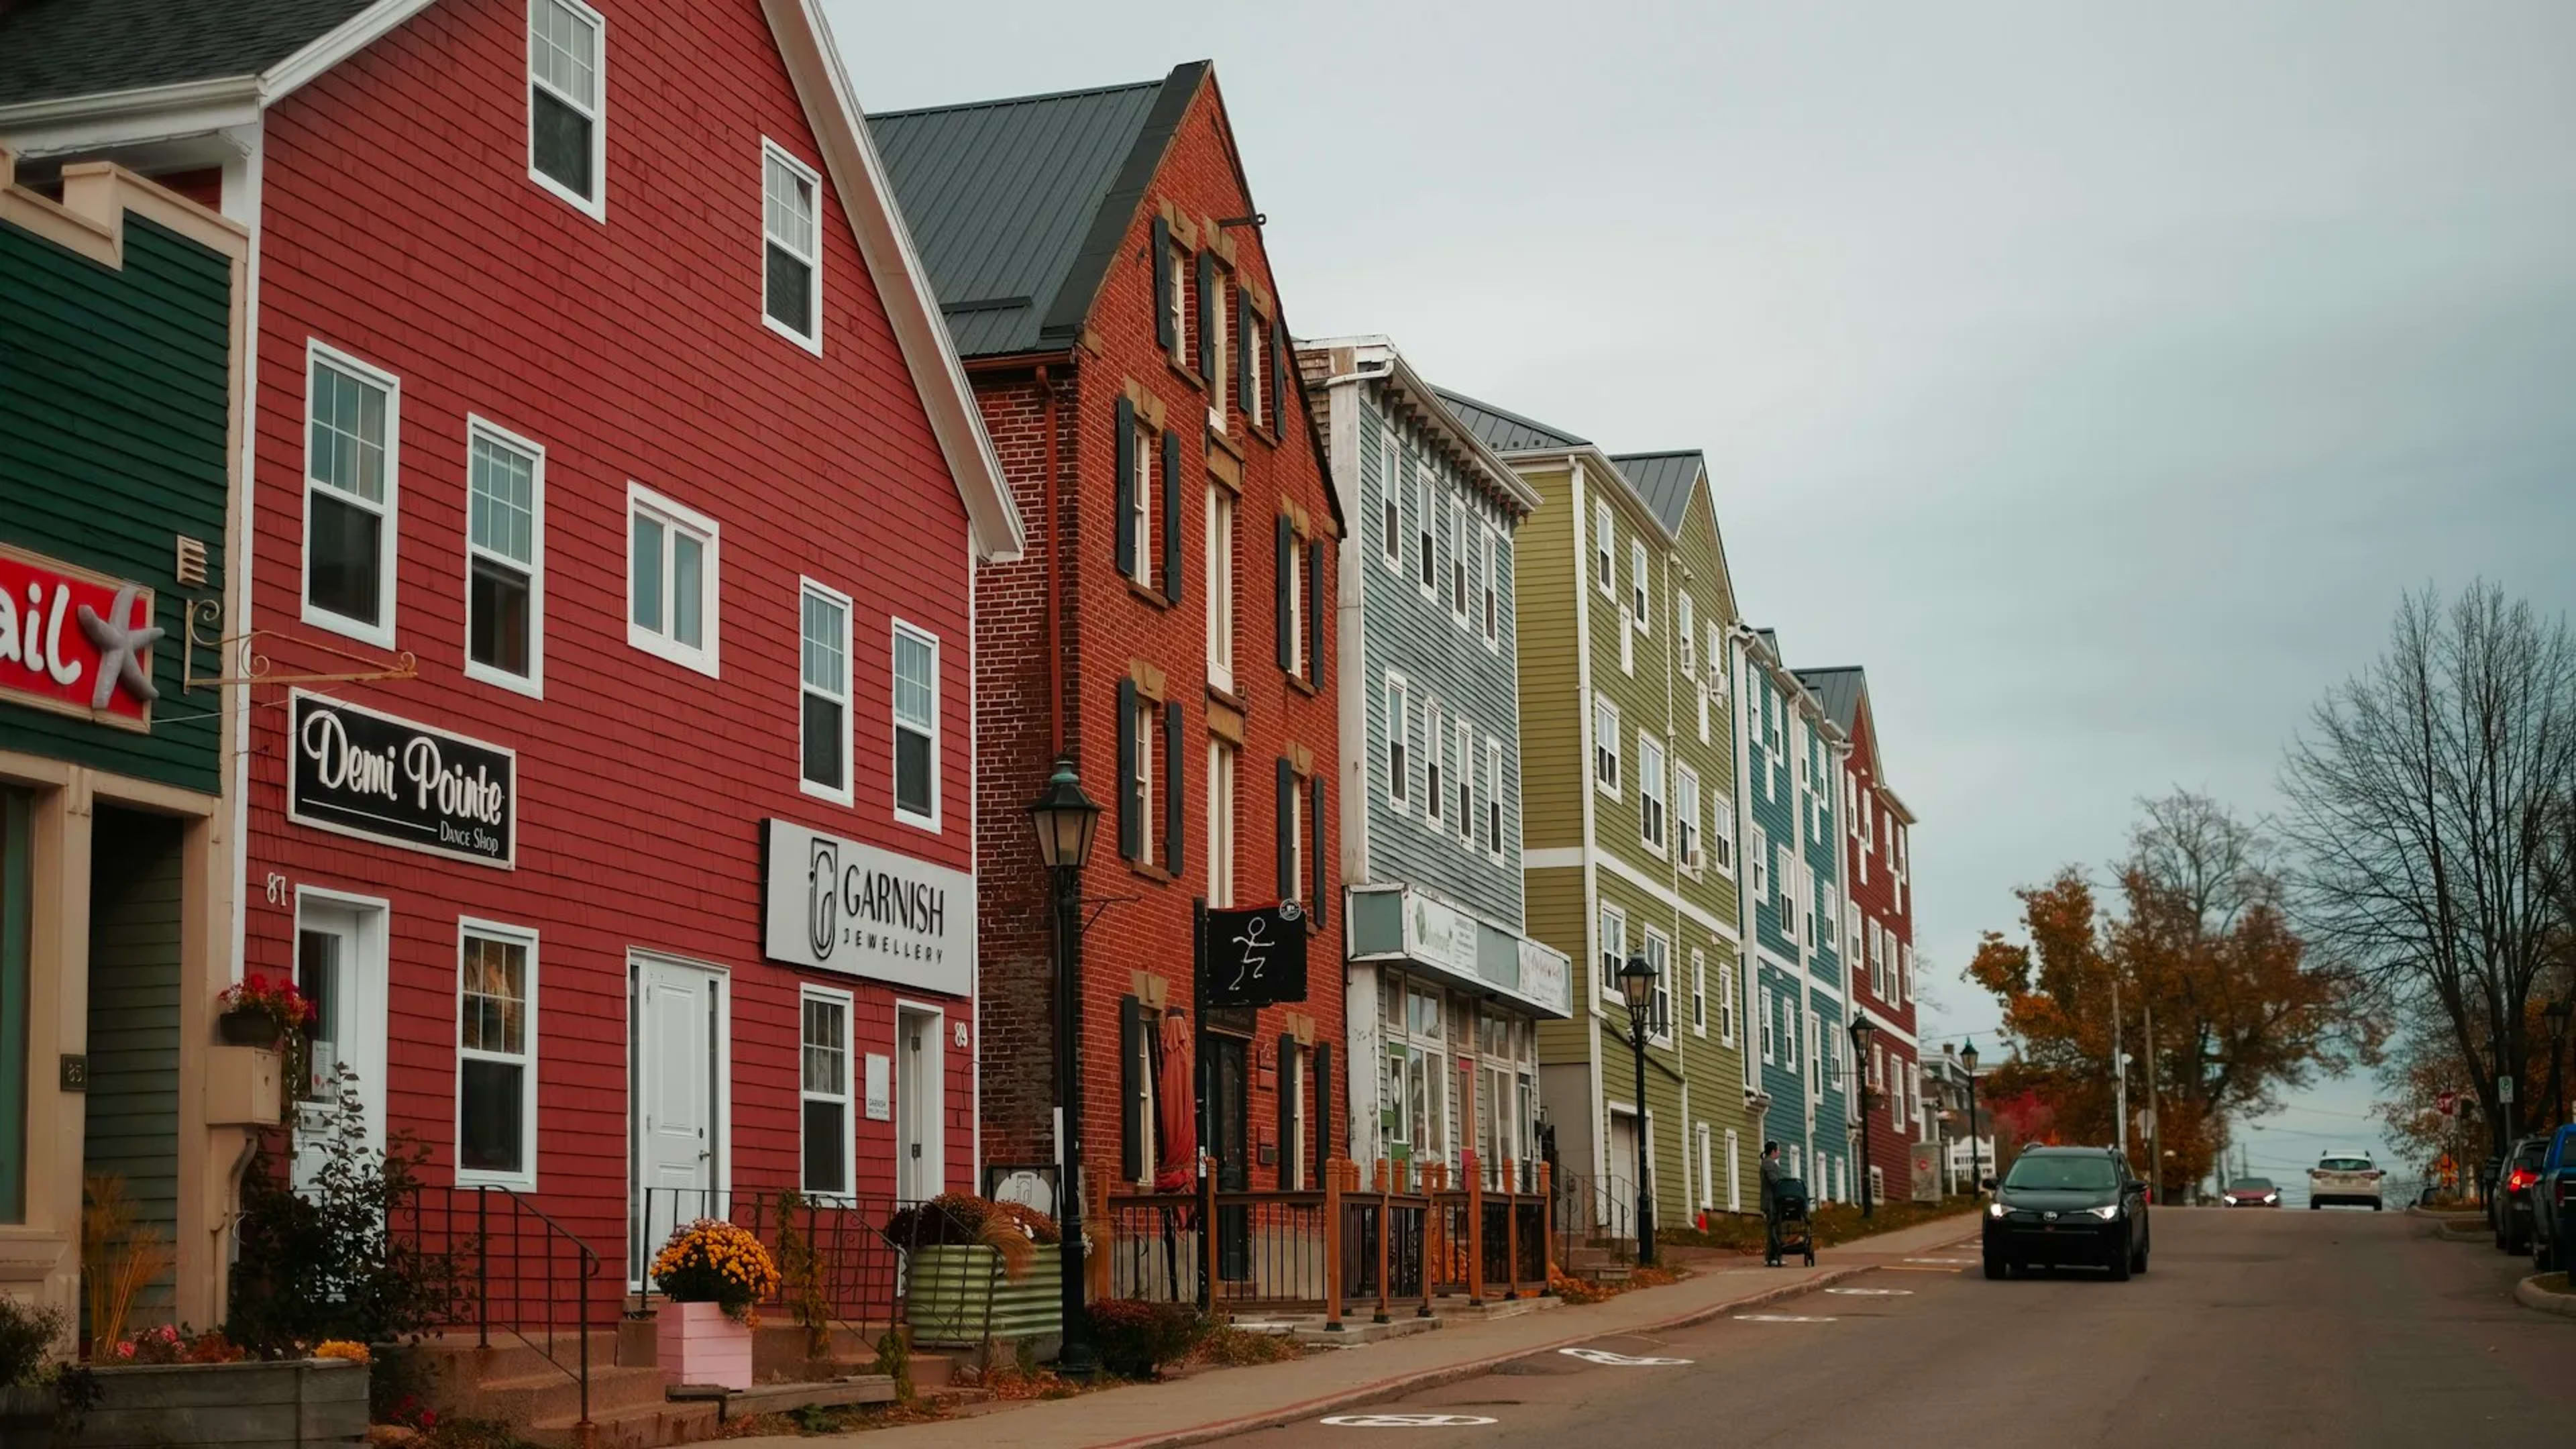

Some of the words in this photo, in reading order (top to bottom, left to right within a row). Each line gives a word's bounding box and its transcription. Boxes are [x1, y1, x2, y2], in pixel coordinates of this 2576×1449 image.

[302, 710, 397, 801] Demi
[404, 737, 502, 826] Pointe
[267, 872, 286, 906] 87
[844, 864, 944, 938] GARNISH
[843, 928, 943, 965] JEWELLERY
[954, 1021, 968, 1047] 89
